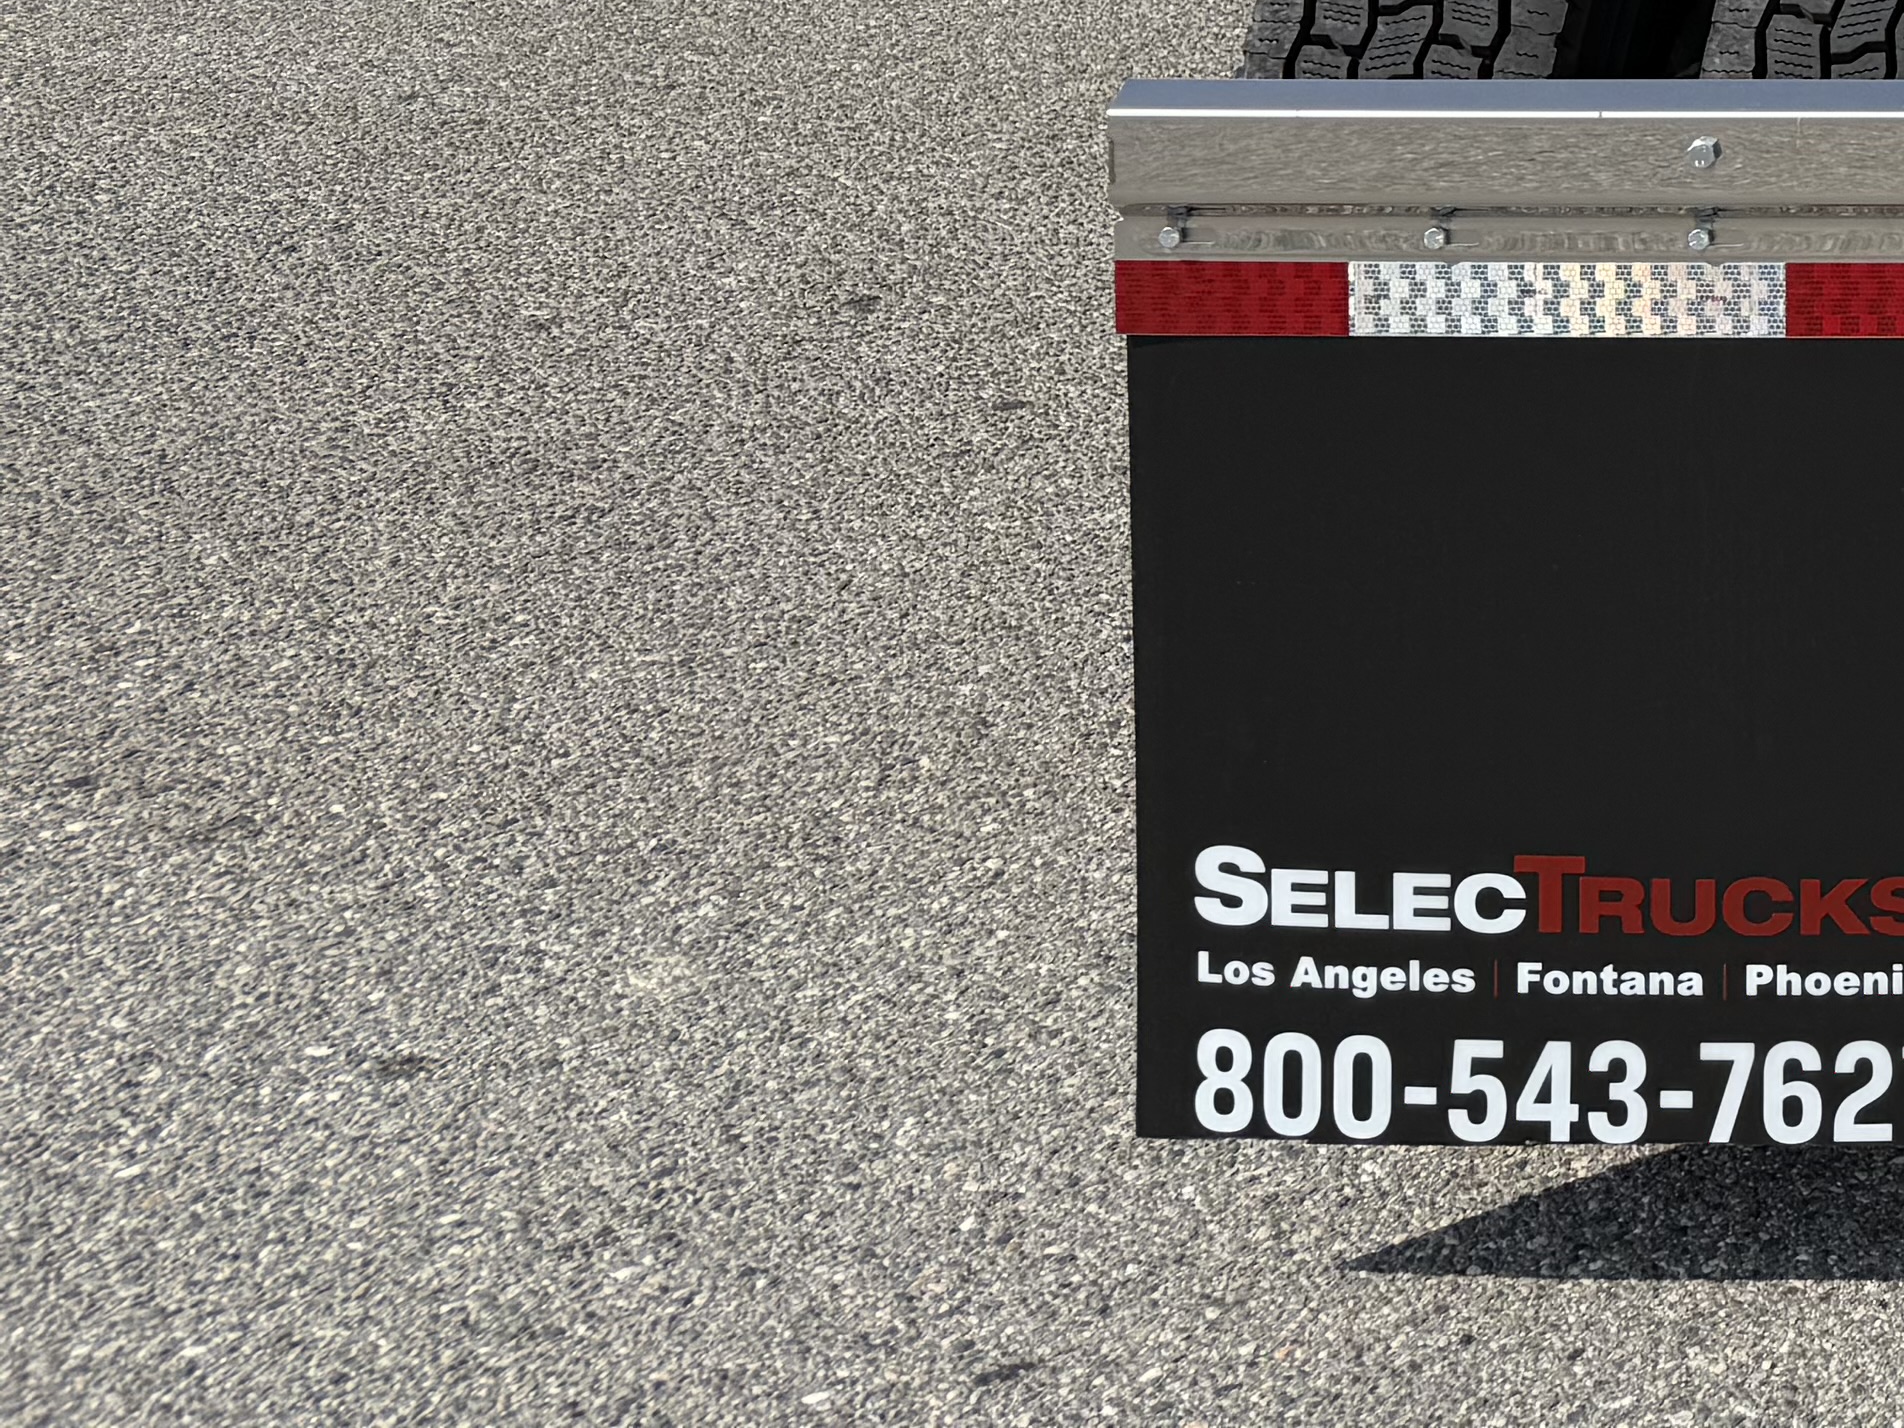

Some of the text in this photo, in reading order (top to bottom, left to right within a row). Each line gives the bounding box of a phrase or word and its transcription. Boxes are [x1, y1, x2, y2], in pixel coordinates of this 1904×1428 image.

[1197, 950, 1276, 987] Los
[1289, 955, 1476, 999] Angeles
[1517, 961, 1704, 997] Fontana
